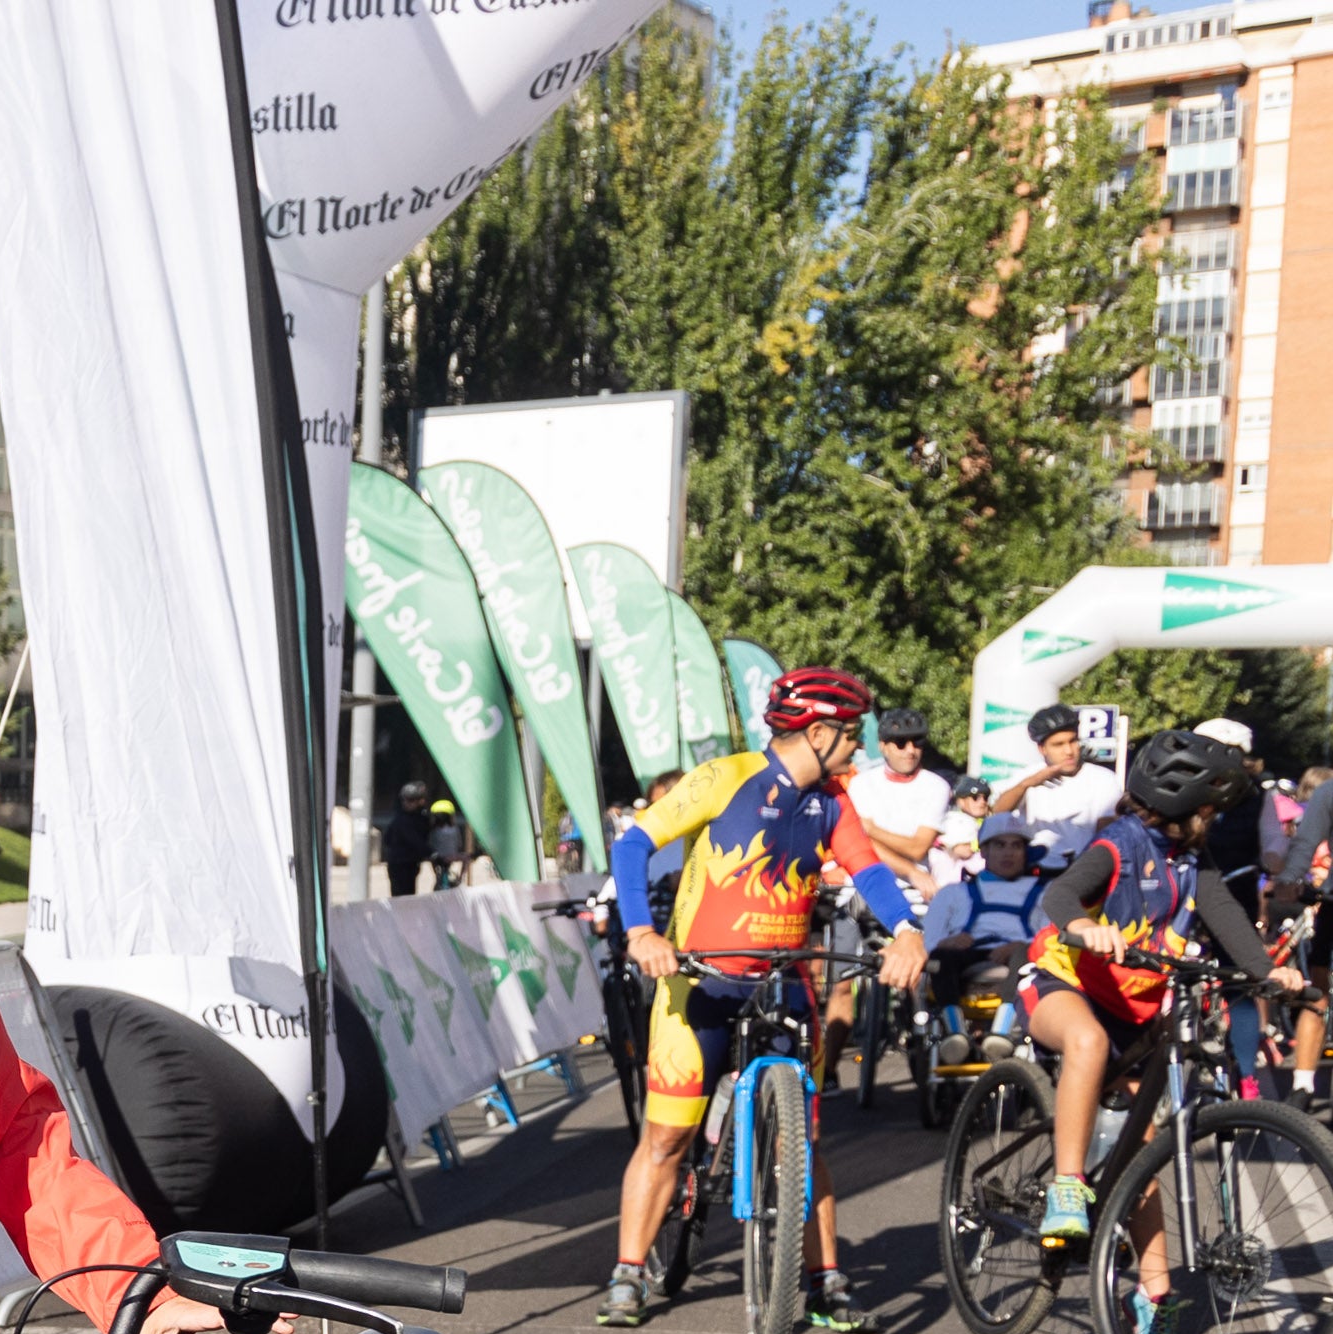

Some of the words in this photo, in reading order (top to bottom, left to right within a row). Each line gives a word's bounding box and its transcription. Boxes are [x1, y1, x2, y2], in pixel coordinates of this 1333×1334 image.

[264, 197, 306, 239] El
[317, 193, 405, 234] Norte
[409, 184, 442, 216] de
[201, 1003, 245, 1036] El
